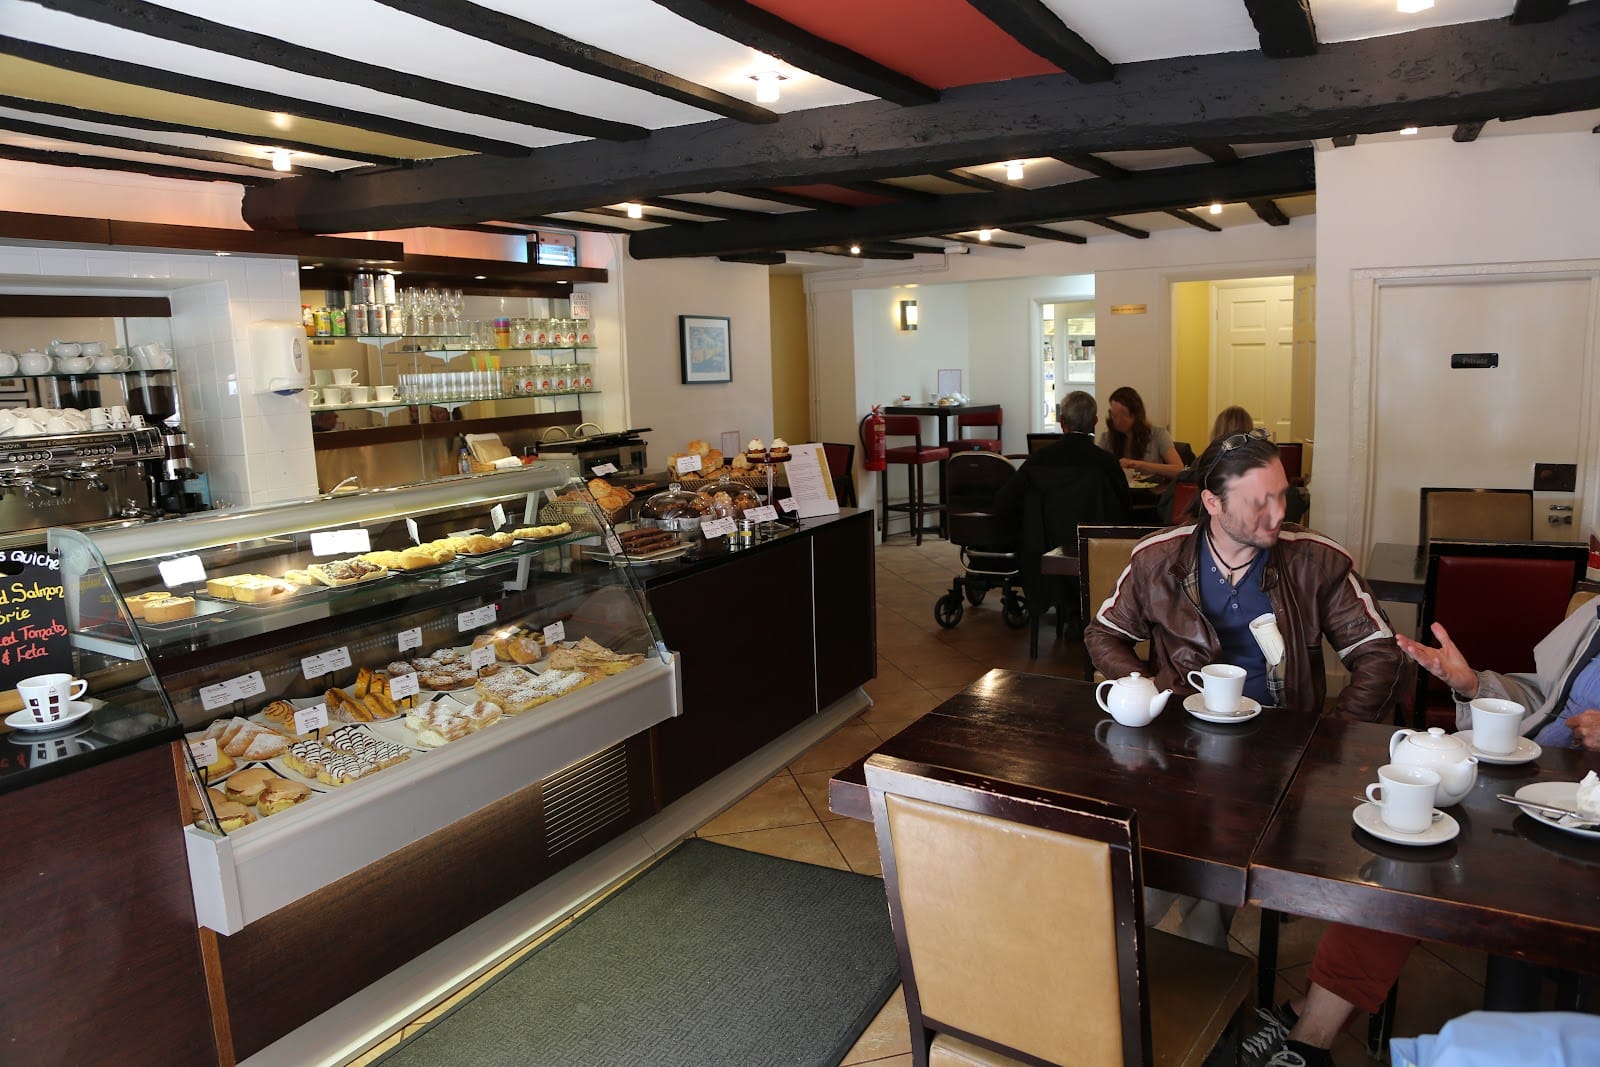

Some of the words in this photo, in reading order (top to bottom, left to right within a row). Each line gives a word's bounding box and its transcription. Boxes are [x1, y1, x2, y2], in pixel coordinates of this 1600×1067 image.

[11, 582, 65, 604] Salmon
[17, 619, 68, 641] Tomato,
[16, 643, 48, 663] Feta
